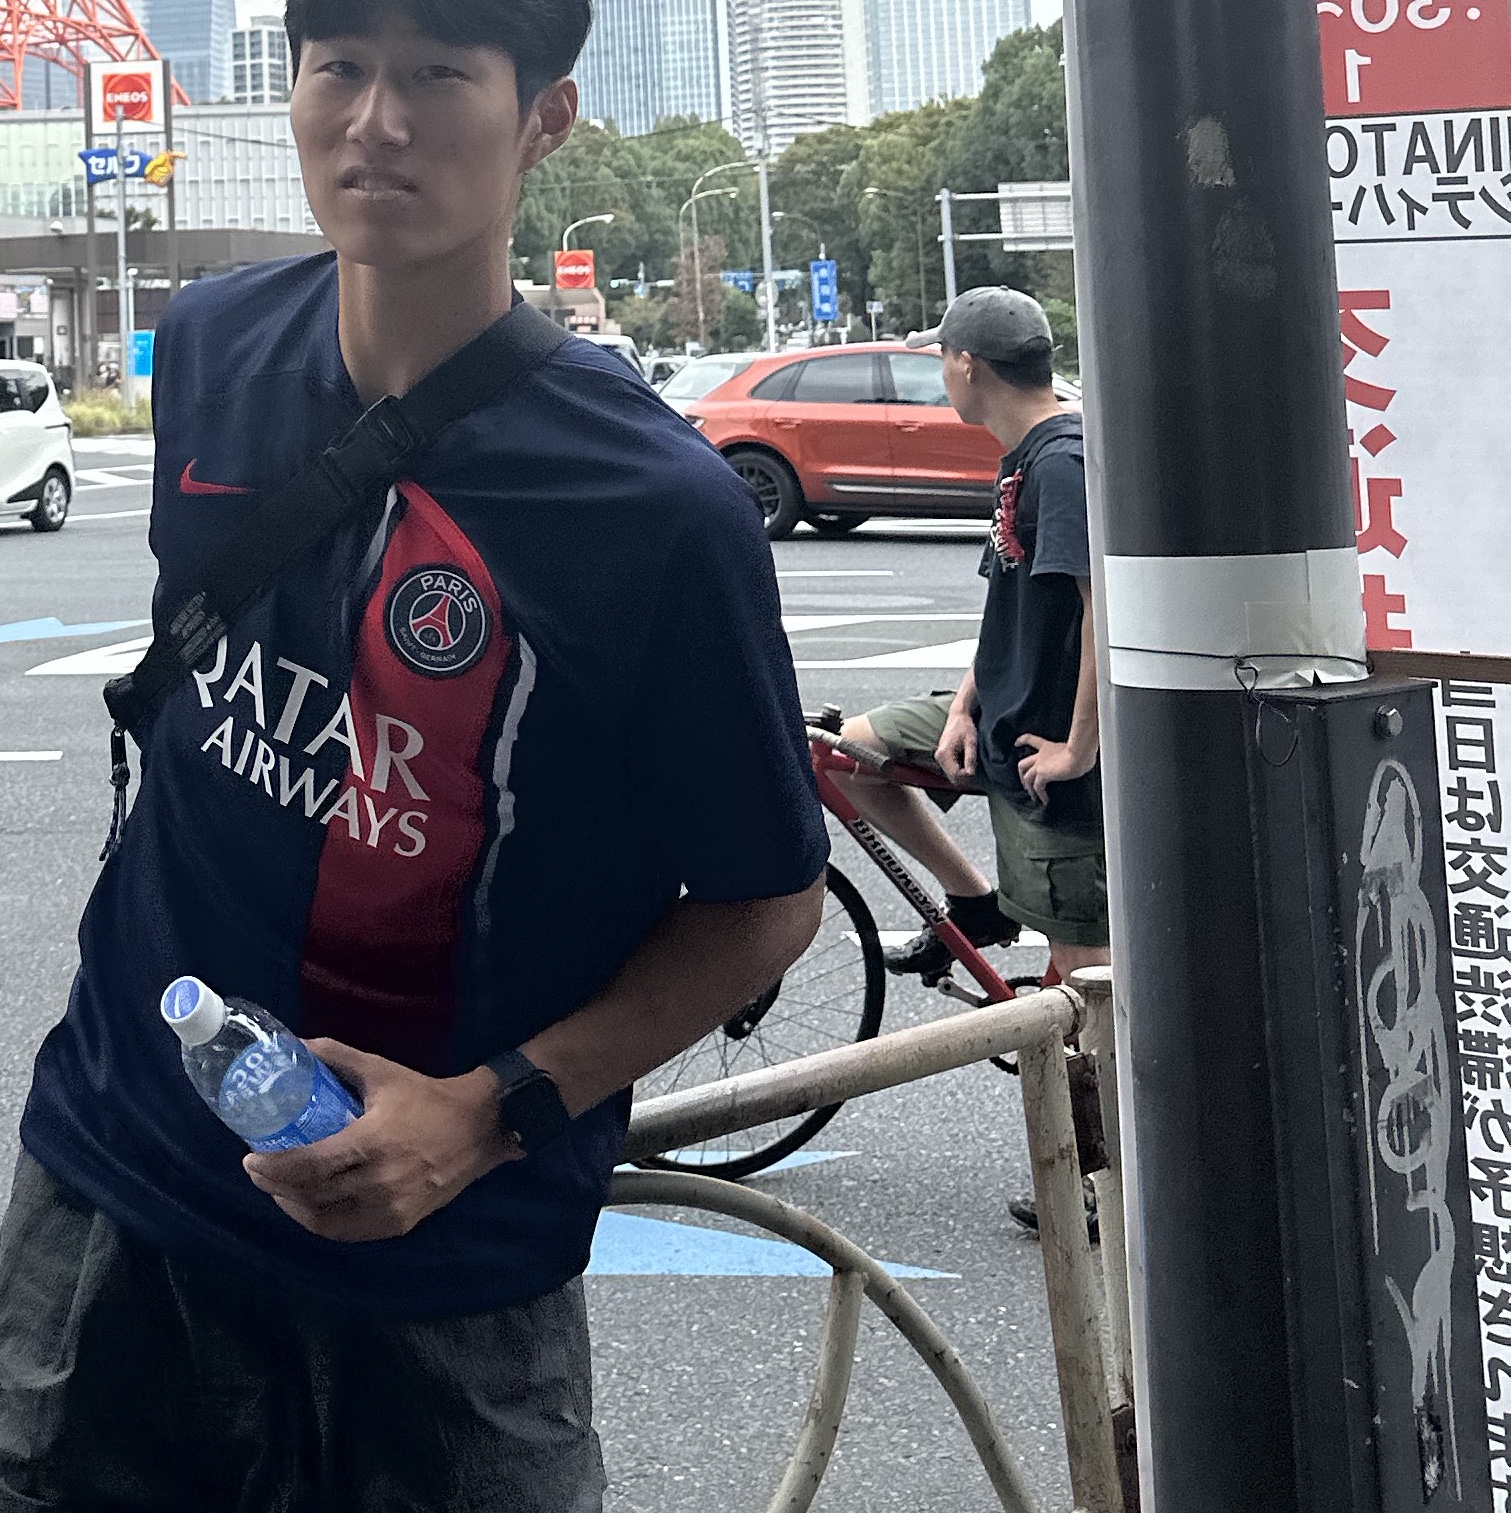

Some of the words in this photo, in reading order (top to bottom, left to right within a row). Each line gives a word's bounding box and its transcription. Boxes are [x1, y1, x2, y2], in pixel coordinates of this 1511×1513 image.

[106, 91, 148, 103] ENEOS
[420, 575, 478, 613] PARIS
[200, 715, 429, 858] AIRWAYS
